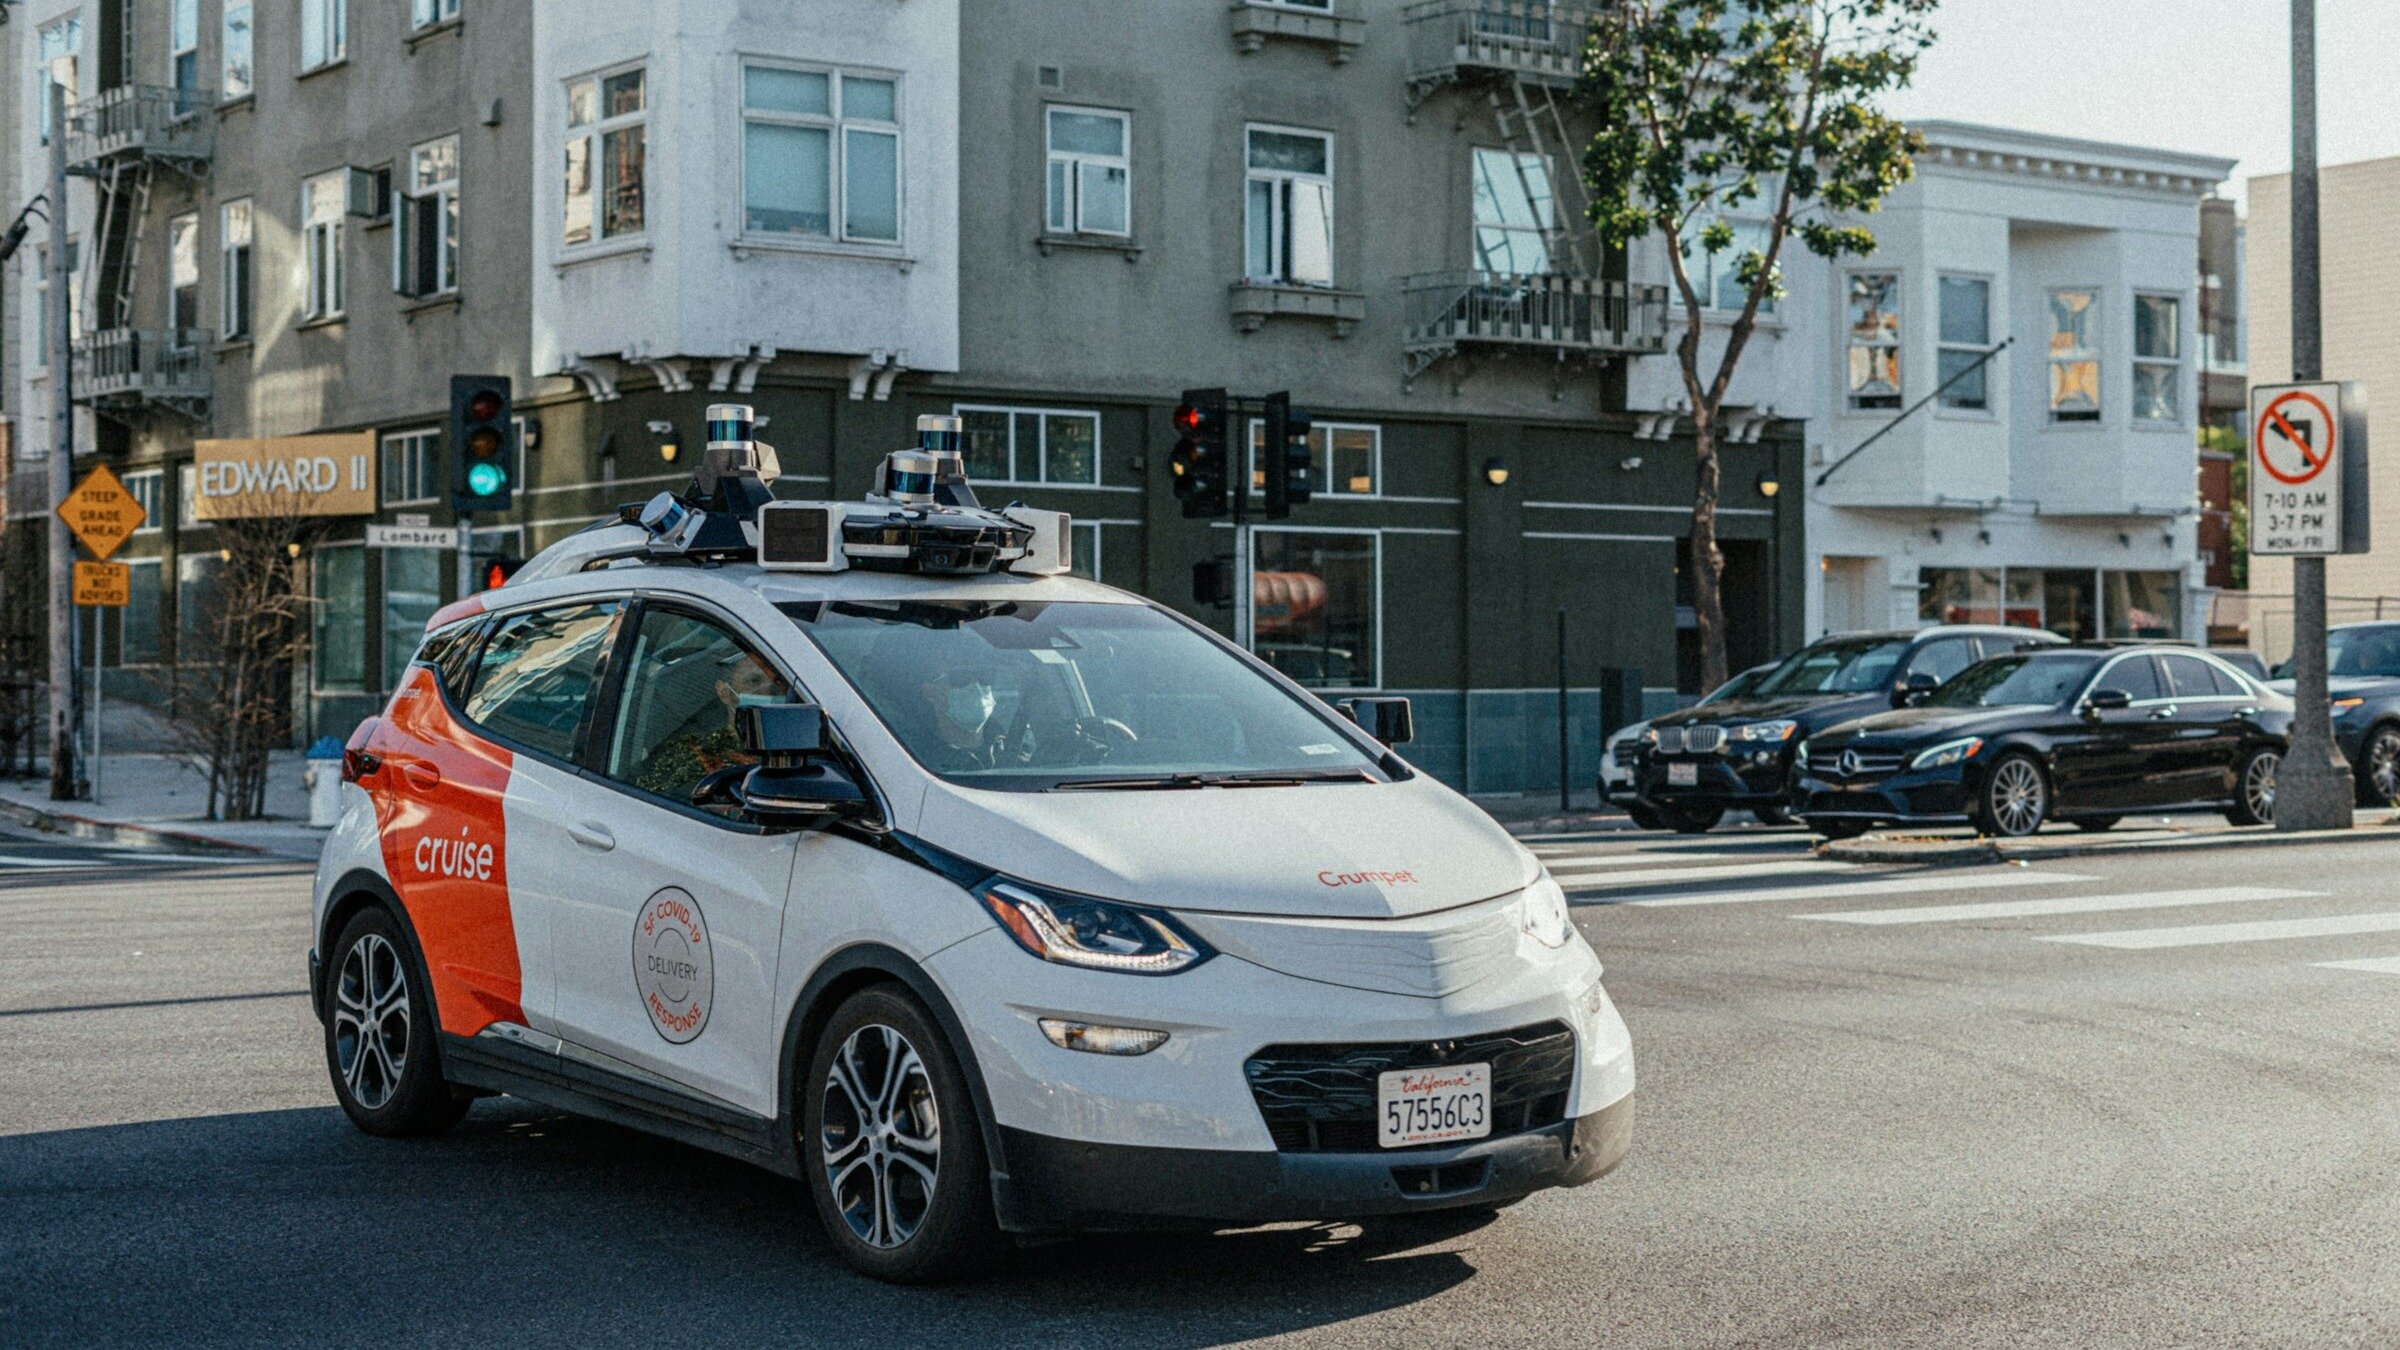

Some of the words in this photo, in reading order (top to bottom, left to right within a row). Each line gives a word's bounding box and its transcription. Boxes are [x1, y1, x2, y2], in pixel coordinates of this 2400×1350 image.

[202, 455, 339, 498] EDWARD
[351, 454, 368, 492] II
[81, 490, 119, 503] STEEP
[2265, 492, 2297, 509] 7-10
[2303, 493, 2327, 508] AM
[79, 509, 121, 522] GRADE
[2269, 515, 2294, 532] 3-7
[2301, 514, 2323, 530] PM
[82, 523, 123, 537] AHEAD
[380, 530, 446, 543] Lombard
[415, 825, 494, 881] cruise
[1318, 870, 1418, 887] Crumpet
[656, 901, 701, 944] COVID-19
[648, 955, 698, 981] DELIVERY
[649, 992, 702, 1033] RESPONSE
[1403, 1074, 1471, 1096] California
[1388, 1093, 1484, 1134] 57556C3
